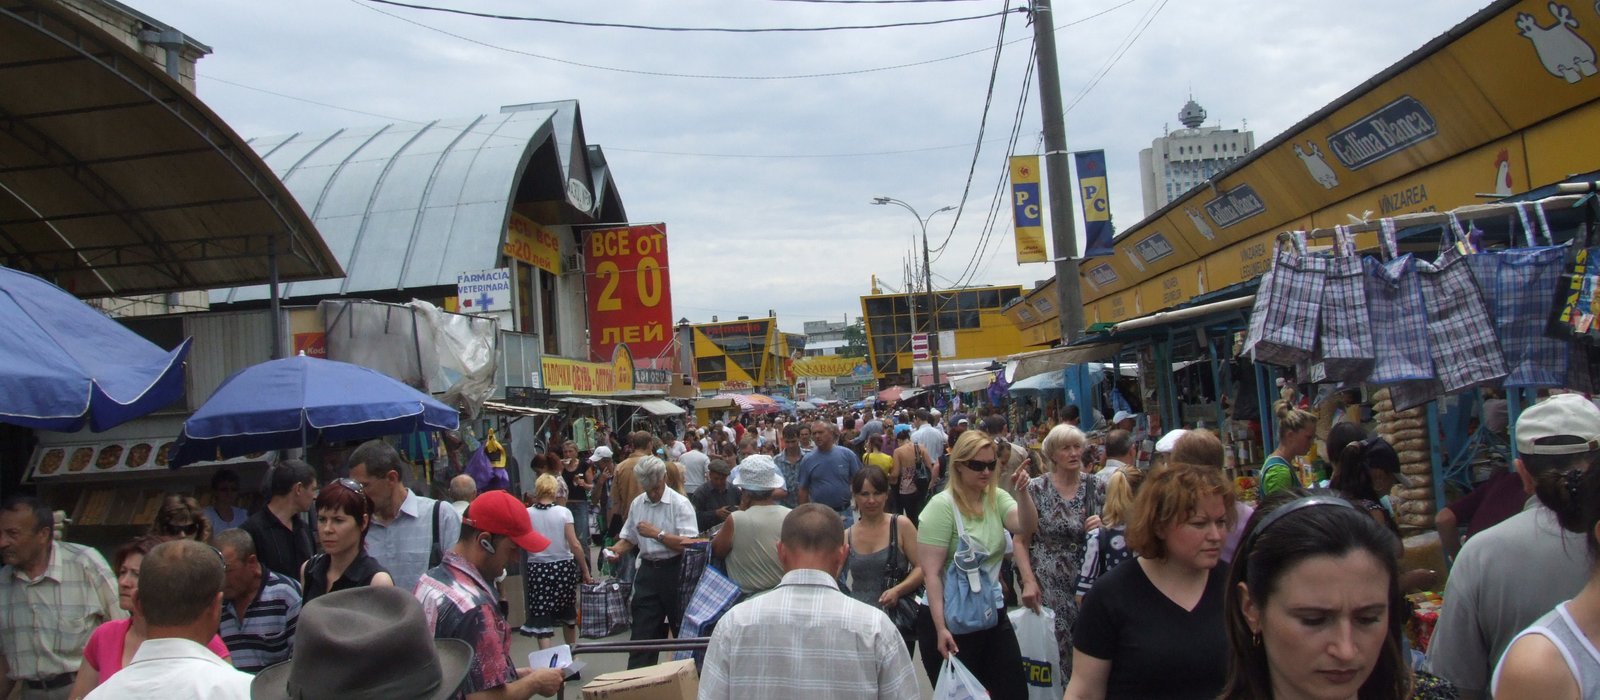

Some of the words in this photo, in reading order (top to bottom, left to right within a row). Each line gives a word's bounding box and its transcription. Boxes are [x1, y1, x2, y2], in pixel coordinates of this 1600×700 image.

[1333, 131, 1386, 165] Gallina
[1370, 111, 1431, 147] Blanca
[515, 239, 531, 261] 20
[591, 230, 630, 257] ВСЕ
[457, 271, 510, 284] FARMACIA
[600, 320, 664, 345] ЛЕЙ
